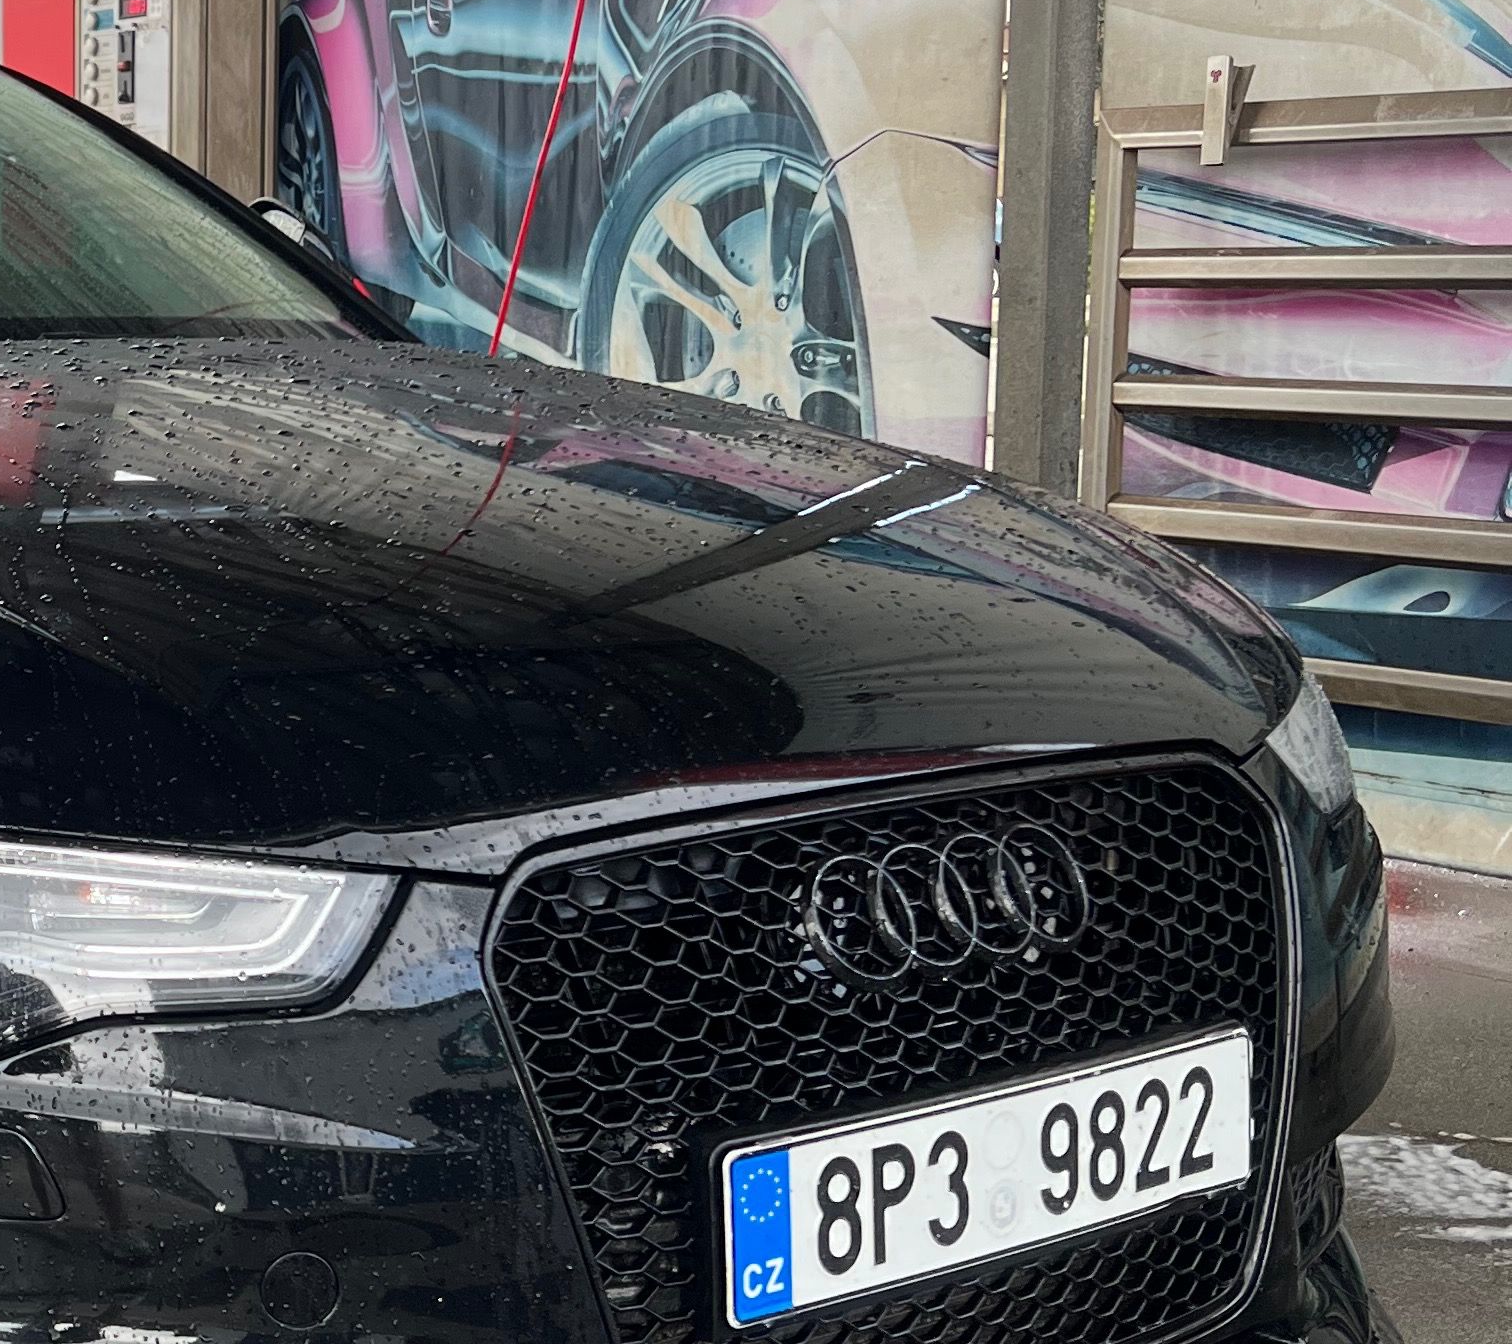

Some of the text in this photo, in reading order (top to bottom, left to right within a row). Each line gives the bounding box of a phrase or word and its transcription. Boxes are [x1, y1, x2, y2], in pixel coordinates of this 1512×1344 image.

[816, 1066, 1214, 1276] 8P3 9822
[743, 1257, 785, 1299] CZ
